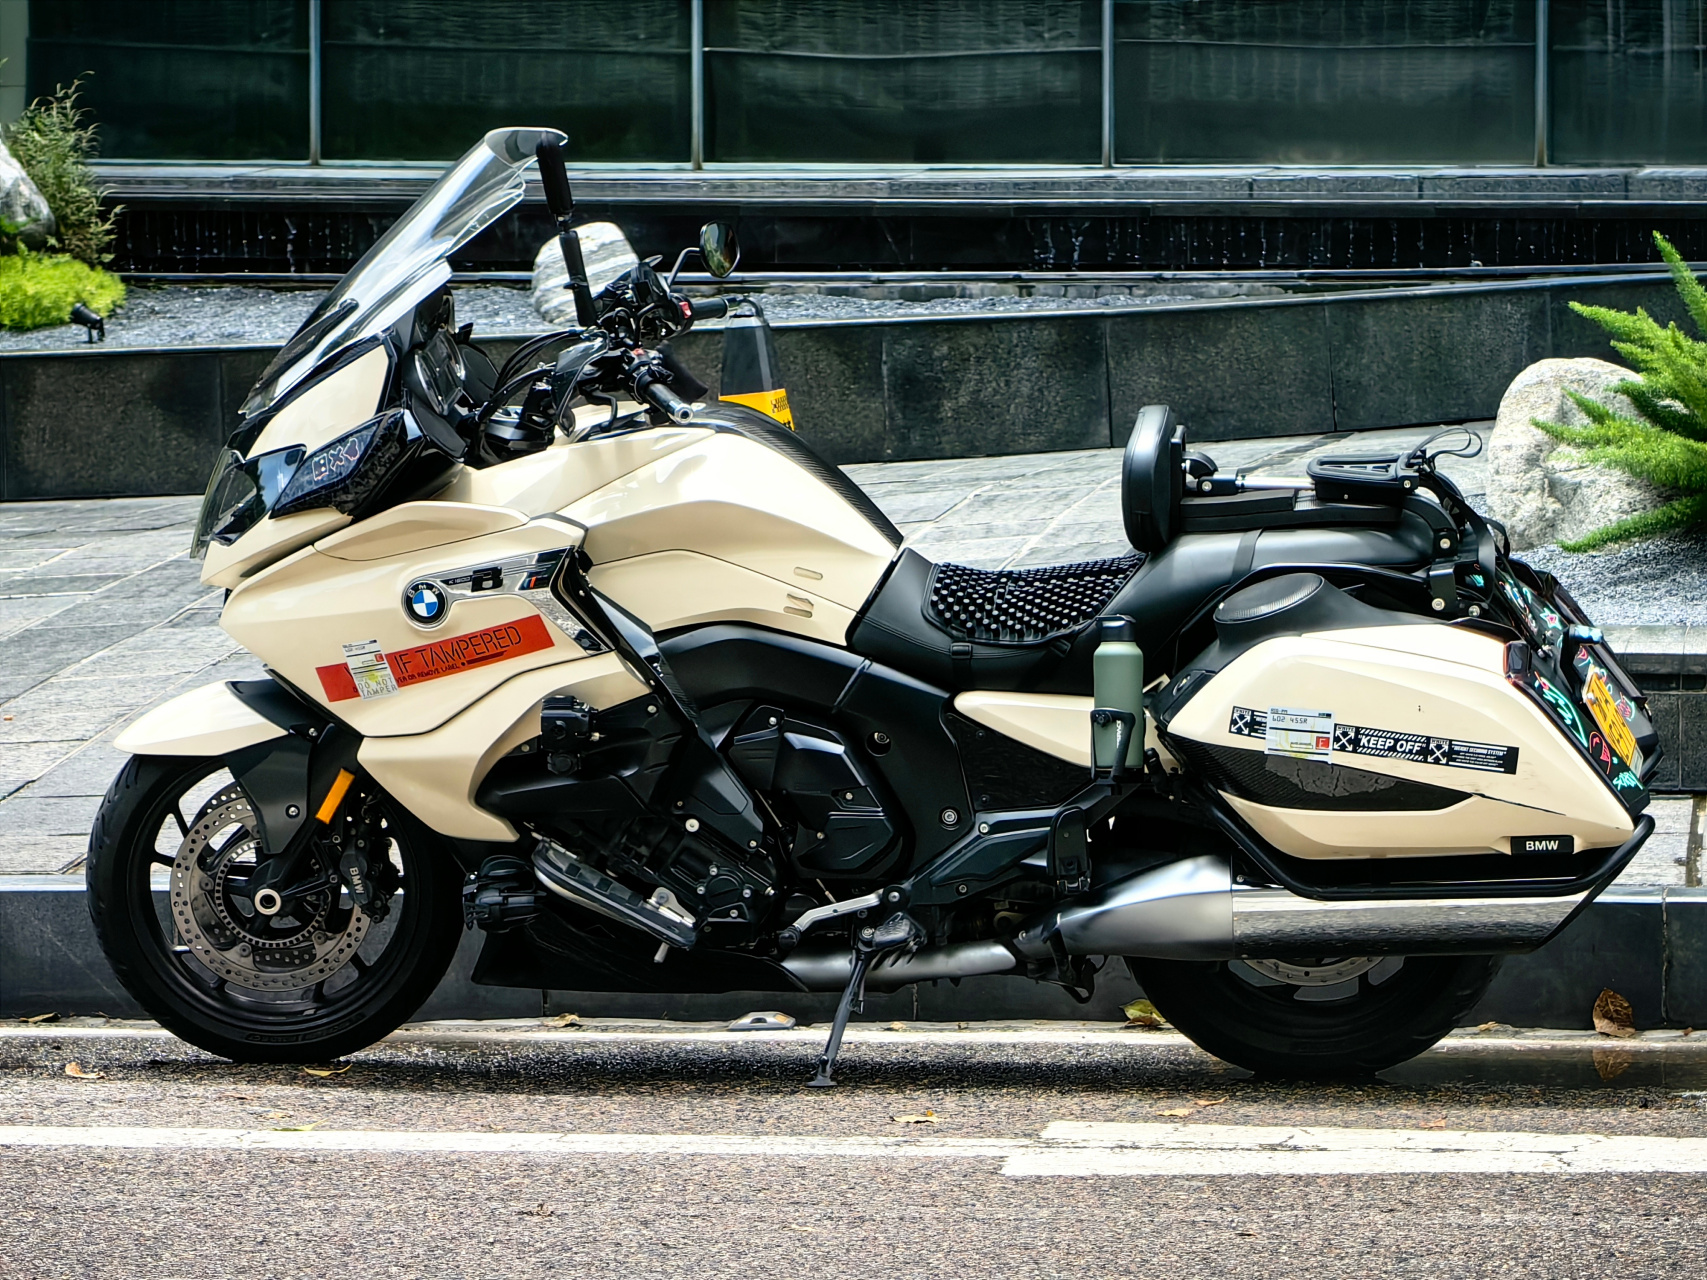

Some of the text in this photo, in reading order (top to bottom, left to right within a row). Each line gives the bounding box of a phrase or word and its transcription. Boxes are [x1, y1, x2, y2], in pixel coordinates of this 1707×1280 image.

[407, 584, 440, 598] BMW
[394, 626, 522, 674] IF TAMPERED
[375, 677, 395, 687] NOT
[362, 683, 398, 697] TAMPER
[1525, 840, 1559, 851] BMW
[349, 866, 365, 894] BMW
